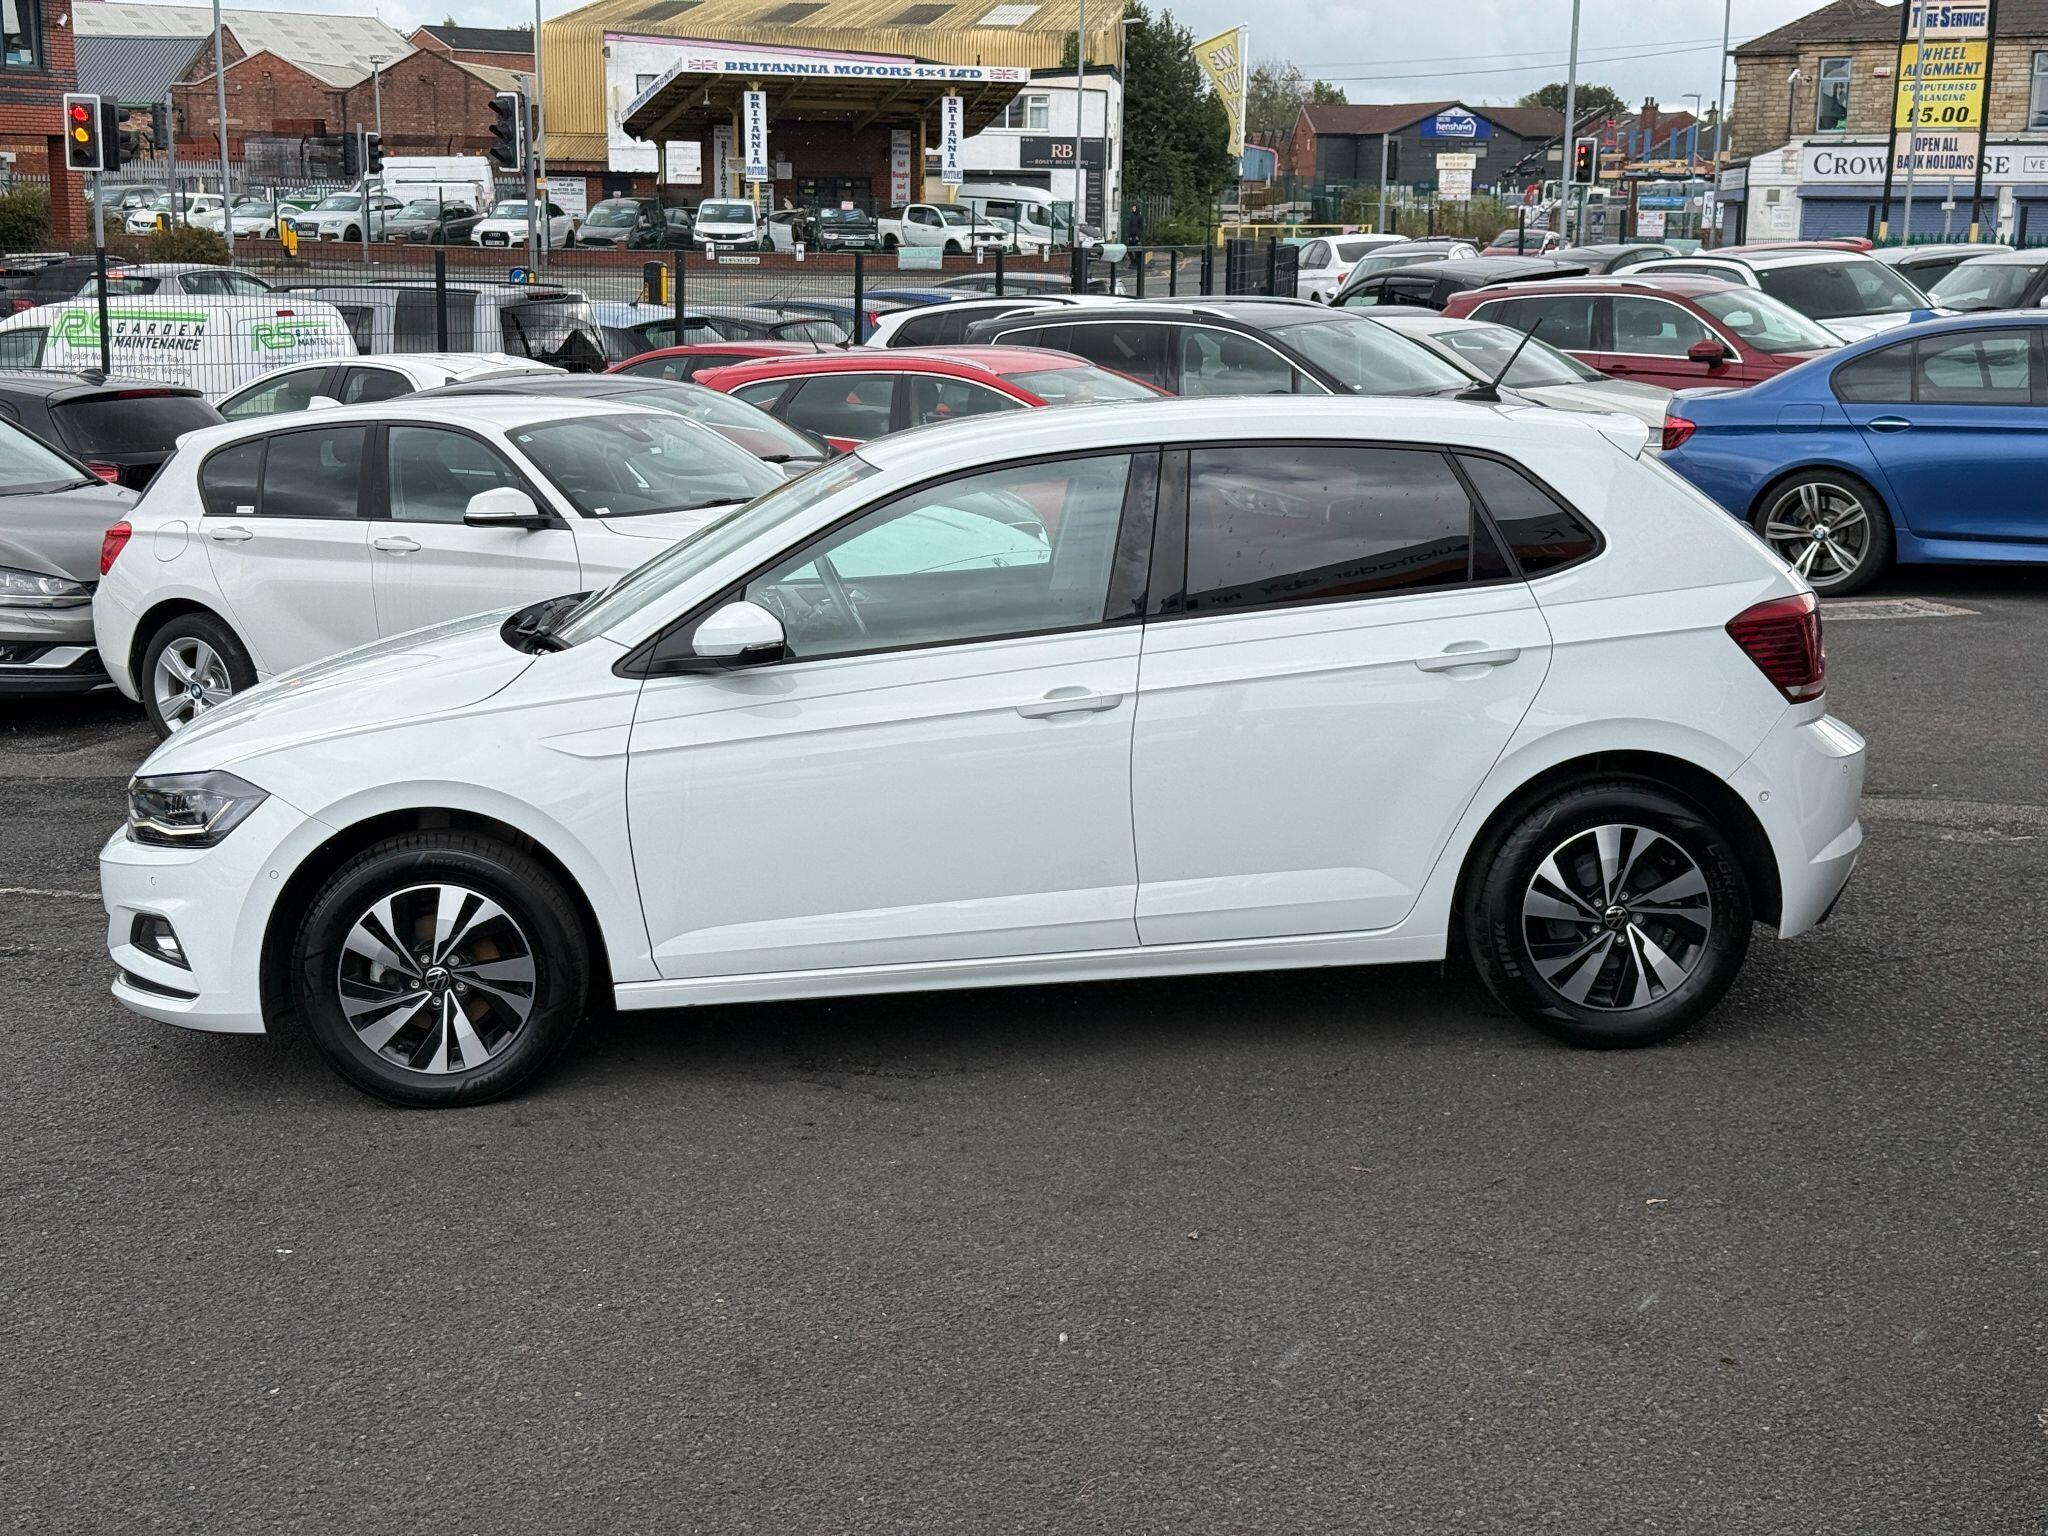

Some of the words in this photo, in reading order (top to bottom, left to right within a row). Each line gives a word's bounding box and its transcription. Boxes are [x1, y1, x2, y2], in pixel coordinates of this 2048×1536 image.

[1912, 7, 1938, 28] TRE
[1940, 6, 1986, 28] SERVICE
[1922, 47, 1967, 60] WHEEL
[725, 61, 829, 74] BRITANNIA
[834, 65, 912, 77] MOTORS
[915, 68, 948, 78] 4x4
[950, 69, 983, 79] LTD
[1903, 61, 1982, 77] ALGNMENT
[749, 93, 762, 165] BRITANNIA
[947, 98, 958, 168] BRITANNIA
[1436, 122, 1472, 131] henshaws
[1051, 144, 1073, 158] RB
[1915, 137, 1941, 152] OPEN
[1942, 137, 1958, 152] ALL
[1926, 154, 1974, 169] HOLIDAYS
[2030, 159, 2048, 170] VE
[746, 166, 767, 175] MOTORS
[117, 322, 205, 337] GARDEN
[114, 337, 202, 351] MAINTENANCE
